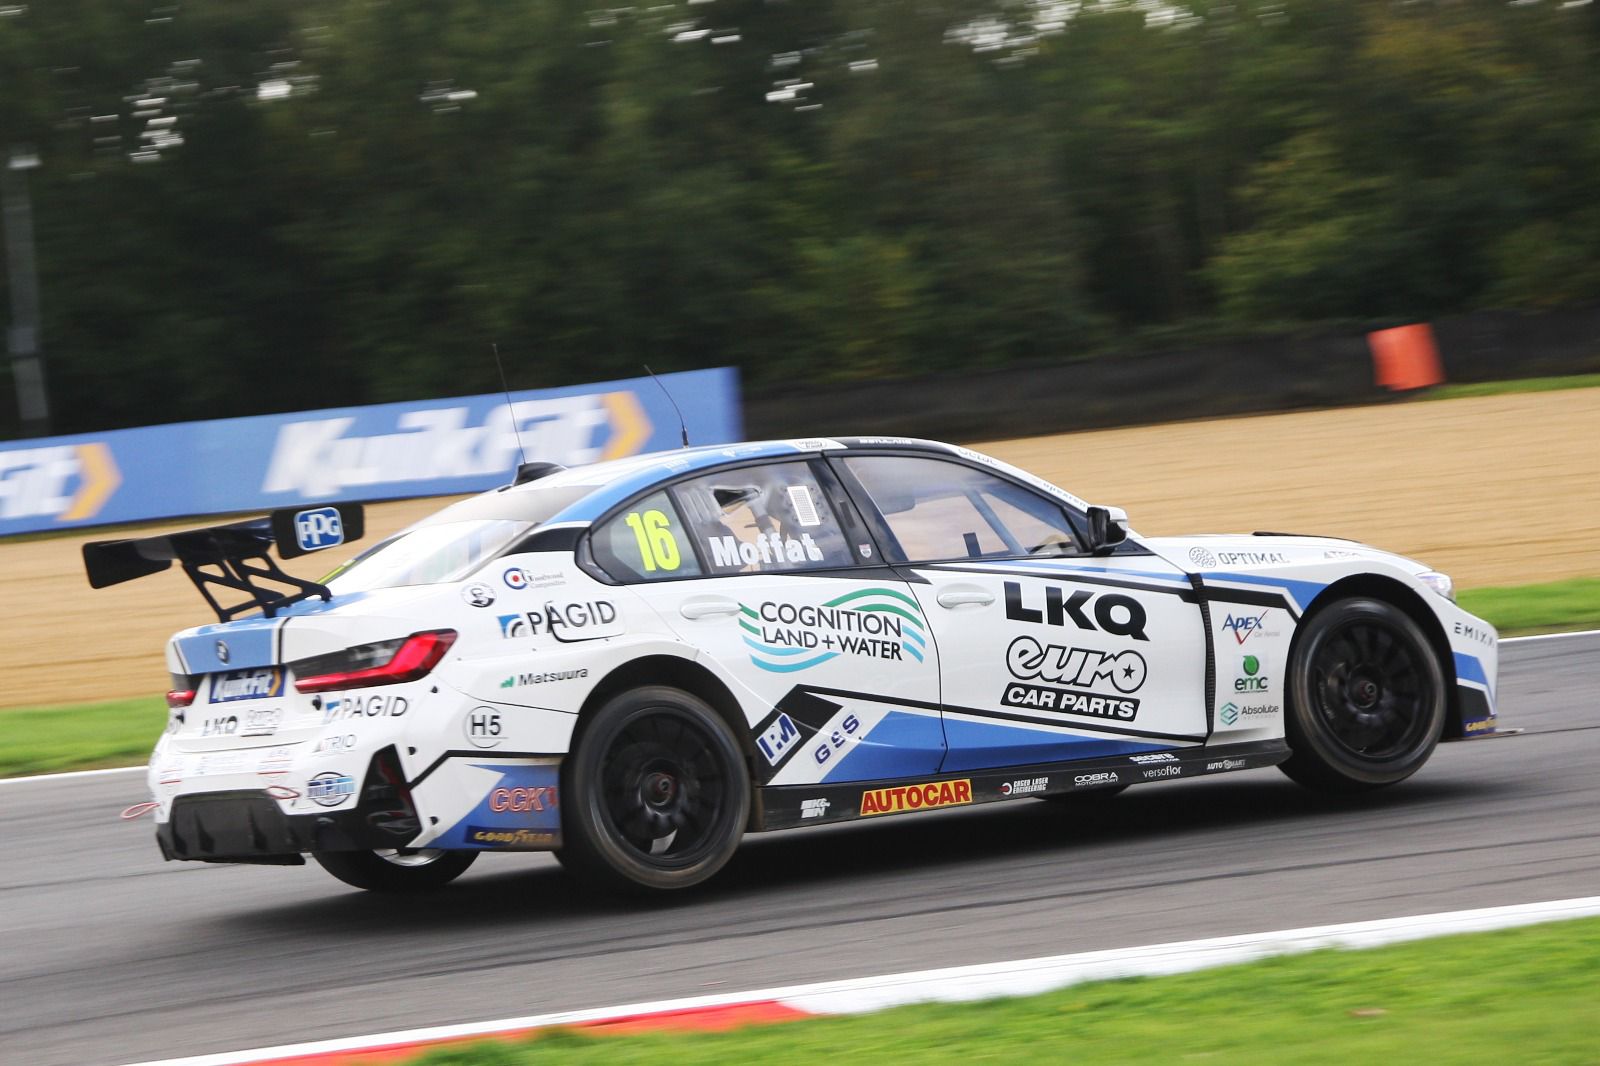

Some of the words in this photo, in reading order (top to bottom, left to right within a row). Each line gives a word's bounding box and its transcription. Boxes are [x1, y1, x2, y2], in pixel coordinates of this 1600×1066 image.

[299, 513, 339, 545] PPG
[625, 510, 681, 571] 16
[709, 533, 824, 567] Moffat
[1218, 552, 1290, 565] OPTIMAL
[526, 600, 615, 635] PAGID
[760, 601, 902, 638] COGNITION
[1003, 580, 1150, 642] LKQ
[762, 626, 818, 649] LAND
[822, 635, 834, 649] +
[837, 635, 902, 661] WATER
[518, 668, 588, 686] Matsuura
[1006, 635, 1147, 694] euro
[1234, 676, 1268, 691] emc
[341, 695, 409, 719] PAGID
[1008, 687, 1056, 708] CAR
[1060, 694, 1134, 718] PARTS
[1241, 704, 1279, 715] Absolute
[471, 715, 501, 736] H5
[1074, 772, 1118, 783] COBRA
[1142, 765, 1181, 778] versoflor
[488, 786, 547, 814] CCK
[861, 781, 970, 814] AUTOCAR
